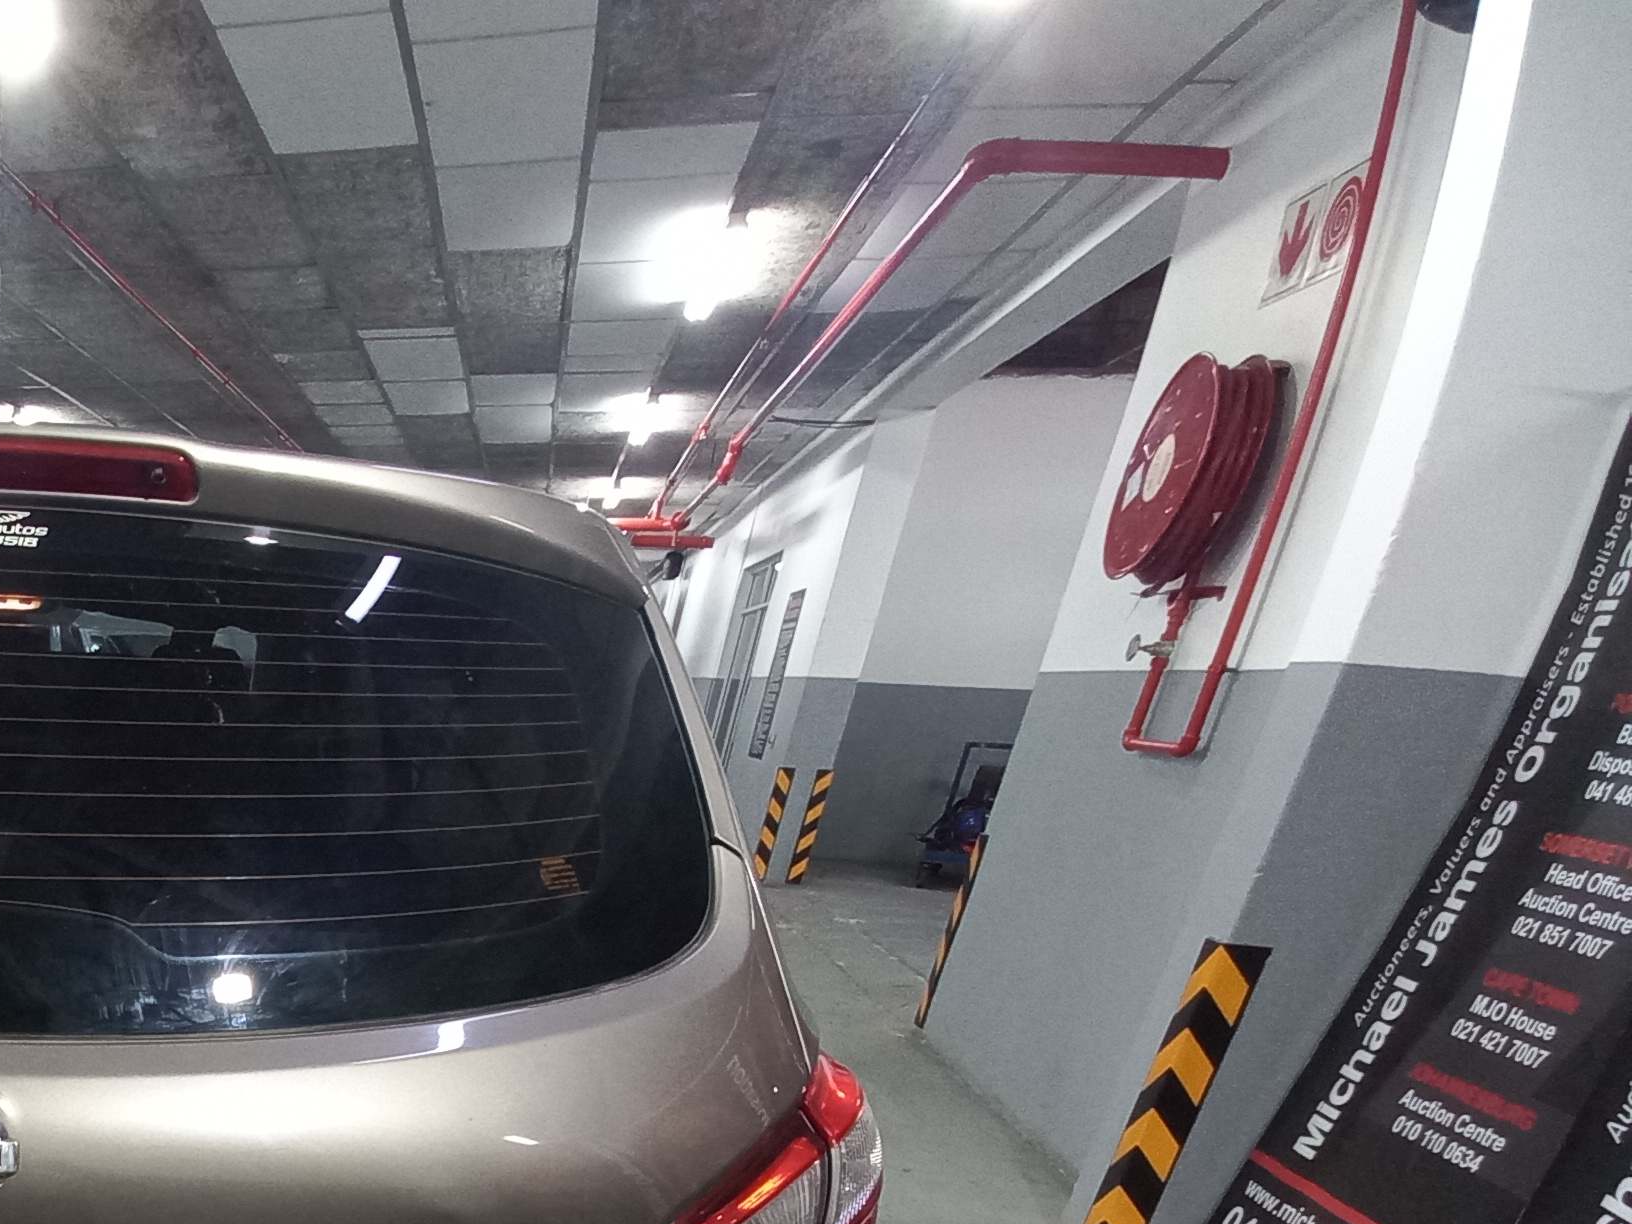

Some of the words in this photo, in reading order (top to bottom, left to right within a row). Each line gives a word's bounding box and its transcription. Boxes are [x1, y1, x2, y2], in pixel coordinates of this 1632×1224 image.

[1354, 904, 1434, 1028] Auctioneers,
[1429, 816, 1481, 894] Valuers
[1480, 767, 1507, 811] and
[1506, 645, 1569, 765] Appraisers
[1570, 493, 1632, 625] Established
[1588, 750, 1632, 777] Dispo
[1584, 780, 1615, 802] 041
[1544, 863, 1589, 889] Head
[1587, 872, 1632, 902] Office
[1518, 888, 1578, 919] Auction
[1579, 902, 1632, 935] Centre
[1511, 916, 1542, 939] 021
[1539, 924, 1571, 948] 851
[1569, 932, 1614, 960] 7007
[1292, 975, 1418, 1160] Michael
[1415, 800, 1518, 966] James
[1469, 994, 1508, 1021] MJO
[1504, 1007, 1557, 1040] House
[1451, 1018, 1482, 1043] 021
[1479, 1030, 1509, 1054] 421
[1505, 1039, 1552, 1069] 7007
[1398, 1089, 1456, 1127] Auction
[1454, 1114, 1506, 1152] Centre
[1392, 1116, 1422, 1141] 010
[1421, 1129, 1447, 1153] 110
[1443, 1142, 1485, 1173] 0634
